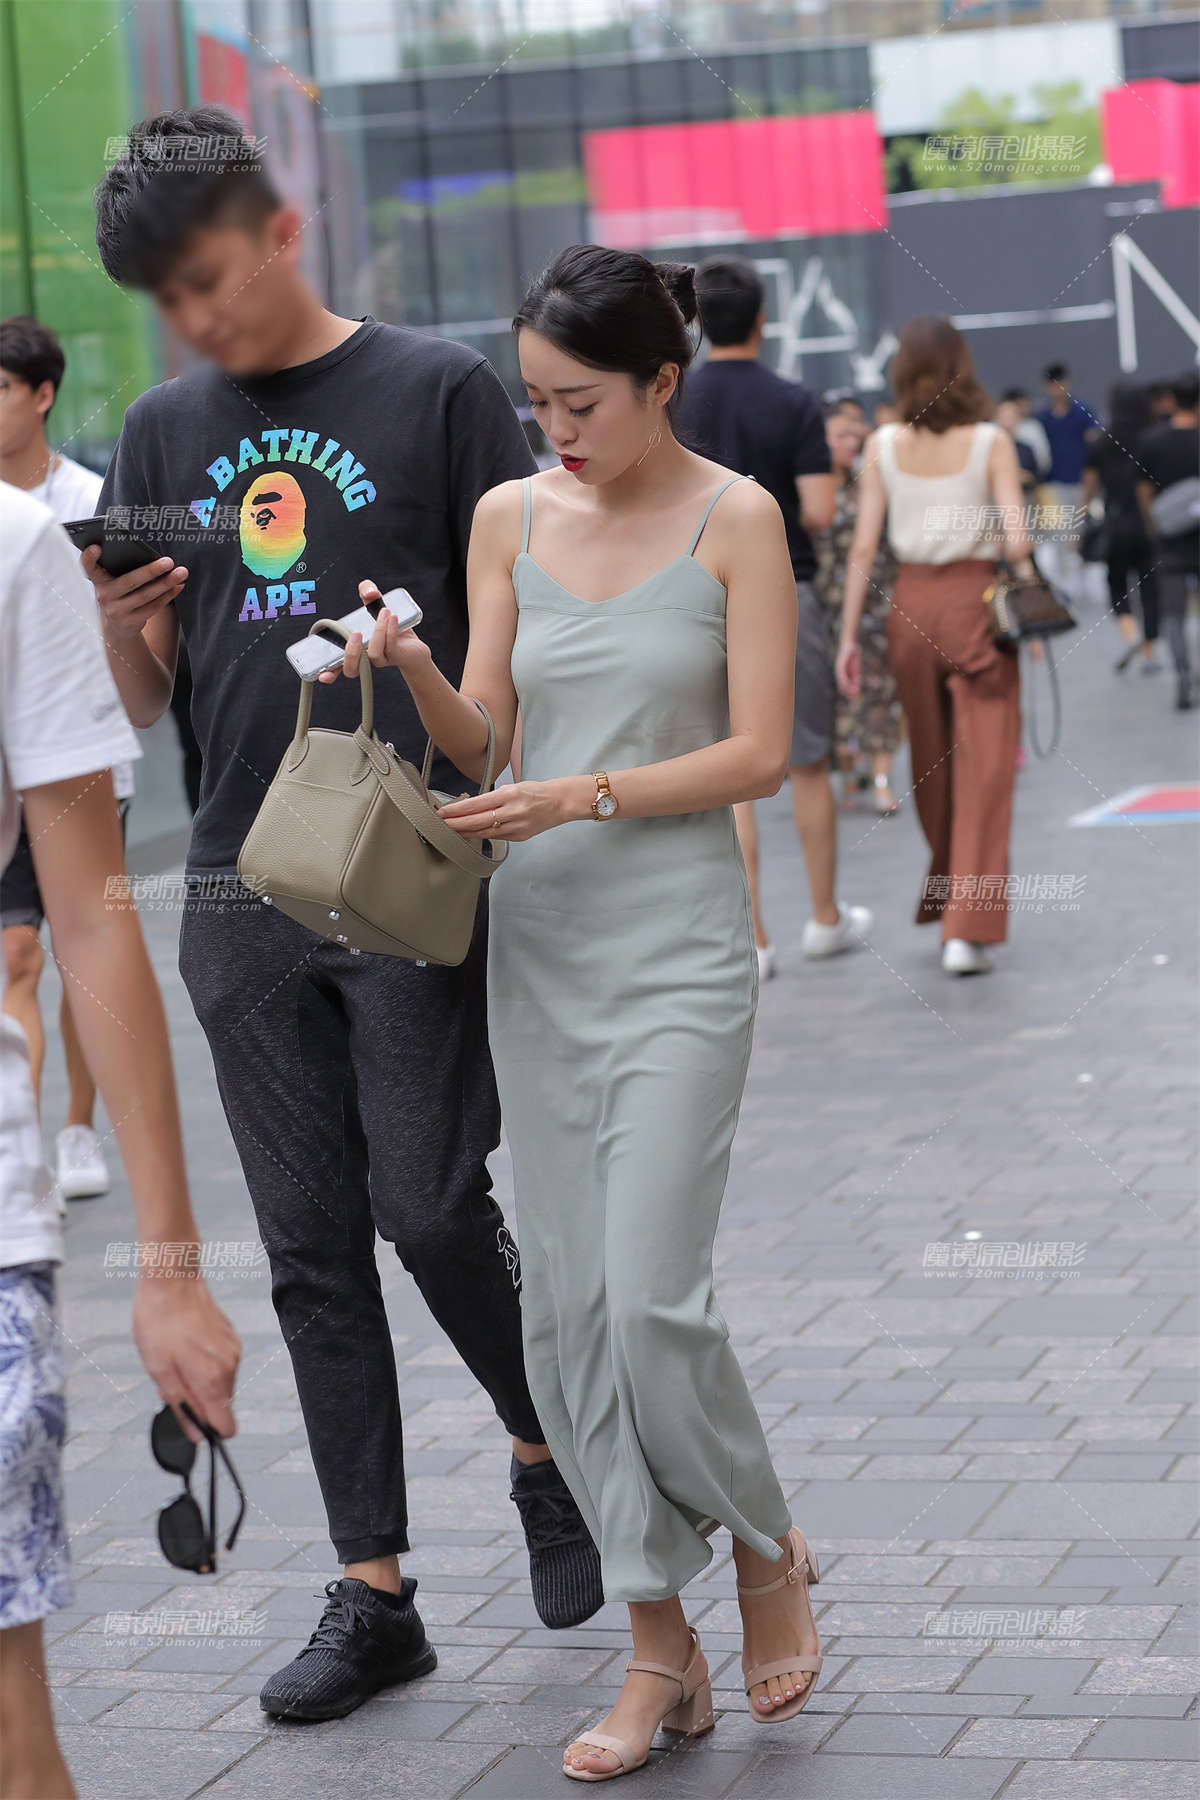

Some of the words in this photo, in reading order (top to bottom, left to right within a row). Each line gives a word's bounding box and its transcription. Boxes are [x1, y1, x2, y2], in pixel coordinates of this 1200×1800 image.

[190, 496, 217, 528] A
[206, 428, 377, 513] BATHING
[238, 580, 317, 622] APE
